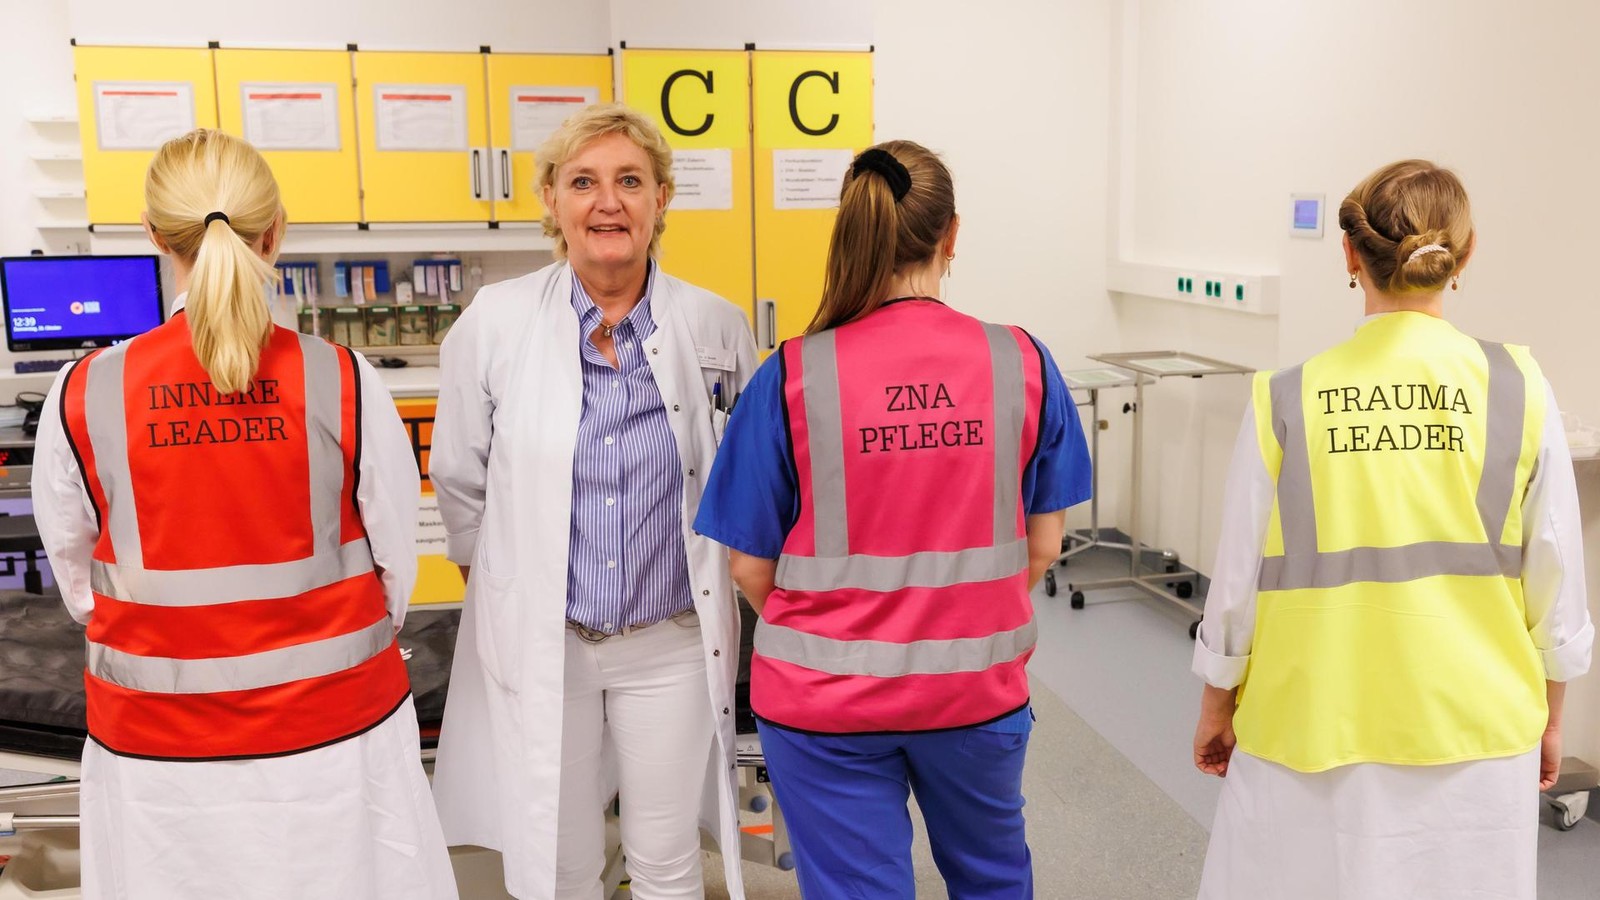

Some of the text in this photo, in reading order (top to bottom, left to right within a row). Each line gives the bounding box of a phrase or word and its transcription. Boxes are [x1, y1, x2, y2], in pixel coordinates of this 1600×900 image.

[660, 69, 715, 137] C
[788, 70, 840, 136] C
[885, 383, 956, 412] ZNA
[1318, 384, 1473, 415] TRAUMA
[147, 416, 289, 448] LEADER
[859, 419, 984, 454] PFLEGE
[1327, 424, 1465, 454] LEADER
